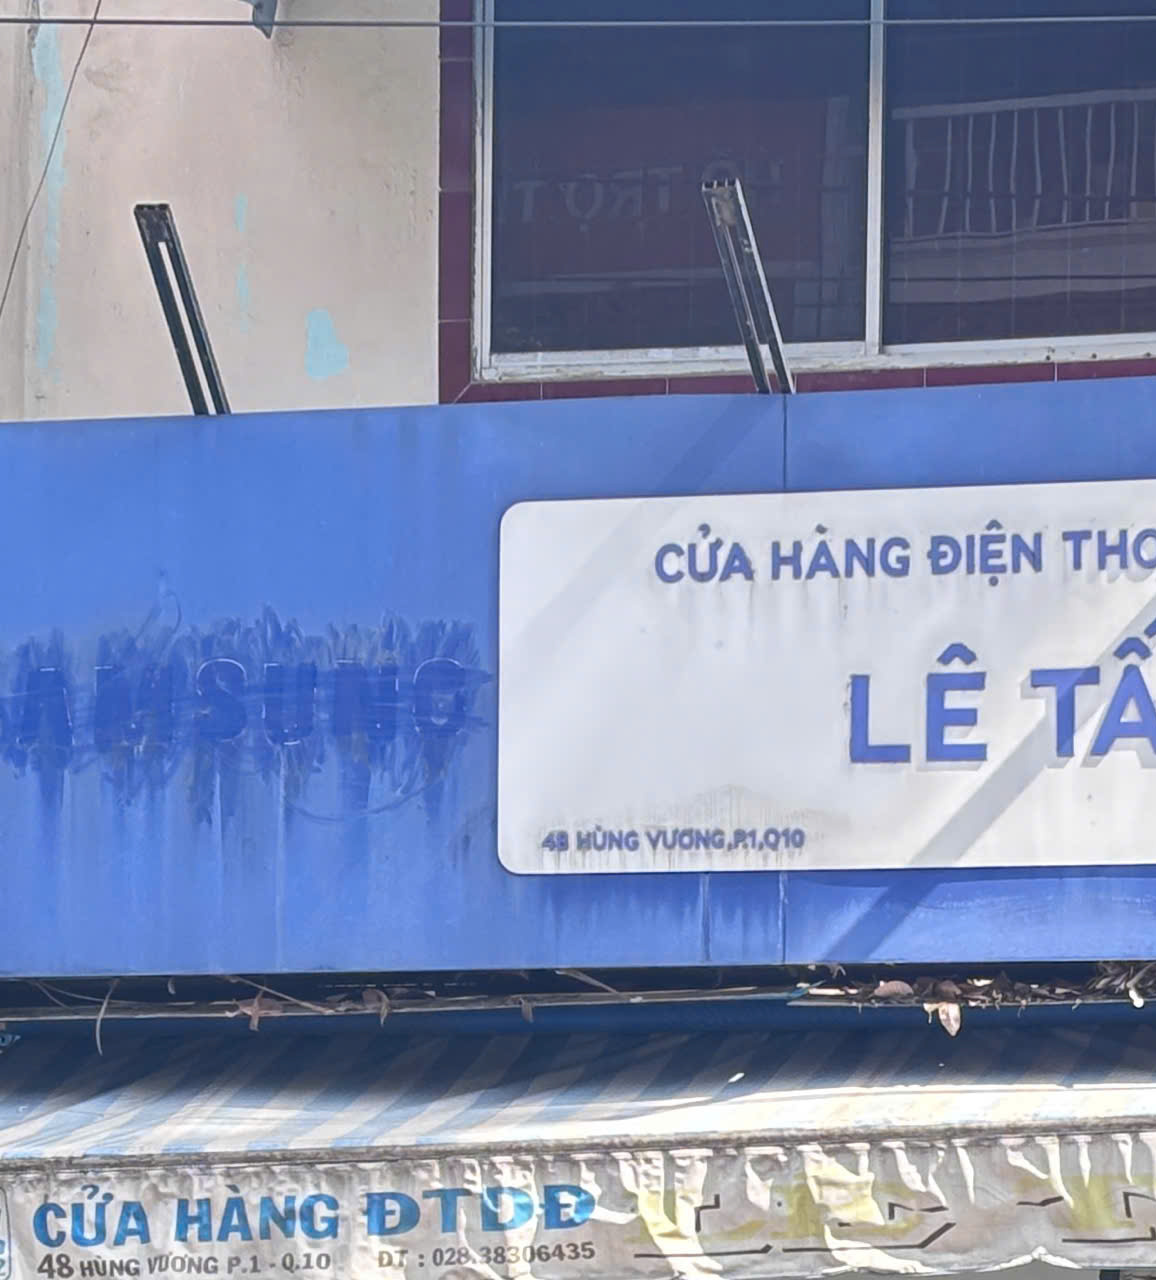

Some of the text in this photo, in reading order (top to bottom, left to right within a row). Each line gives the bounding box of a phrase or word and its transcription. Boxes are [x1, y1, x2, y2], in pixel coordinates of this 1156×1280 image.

[654, 523, 754, 584] CỬA
[770, 522, 911, 581] HÀNG
[927, 518, 1043, 588] ĐIỆN
[848, 642, 988, 764] LÊ
[576, 824, 640, 852] HÙNG
[32, 1183, 597, 1248] CỬA HÀNG ĐTDĐ
[37, 1253, 74, 1280] 48
[79, 1248, 141, 1277] HÙNG
[147, 1252, 219, 1276] VƯƠNG
[226, 1254, 261, 1274] P.1
[281, 1253, 331, 1274] Q.10
[377, 1249, 409, 1268] ĐT
